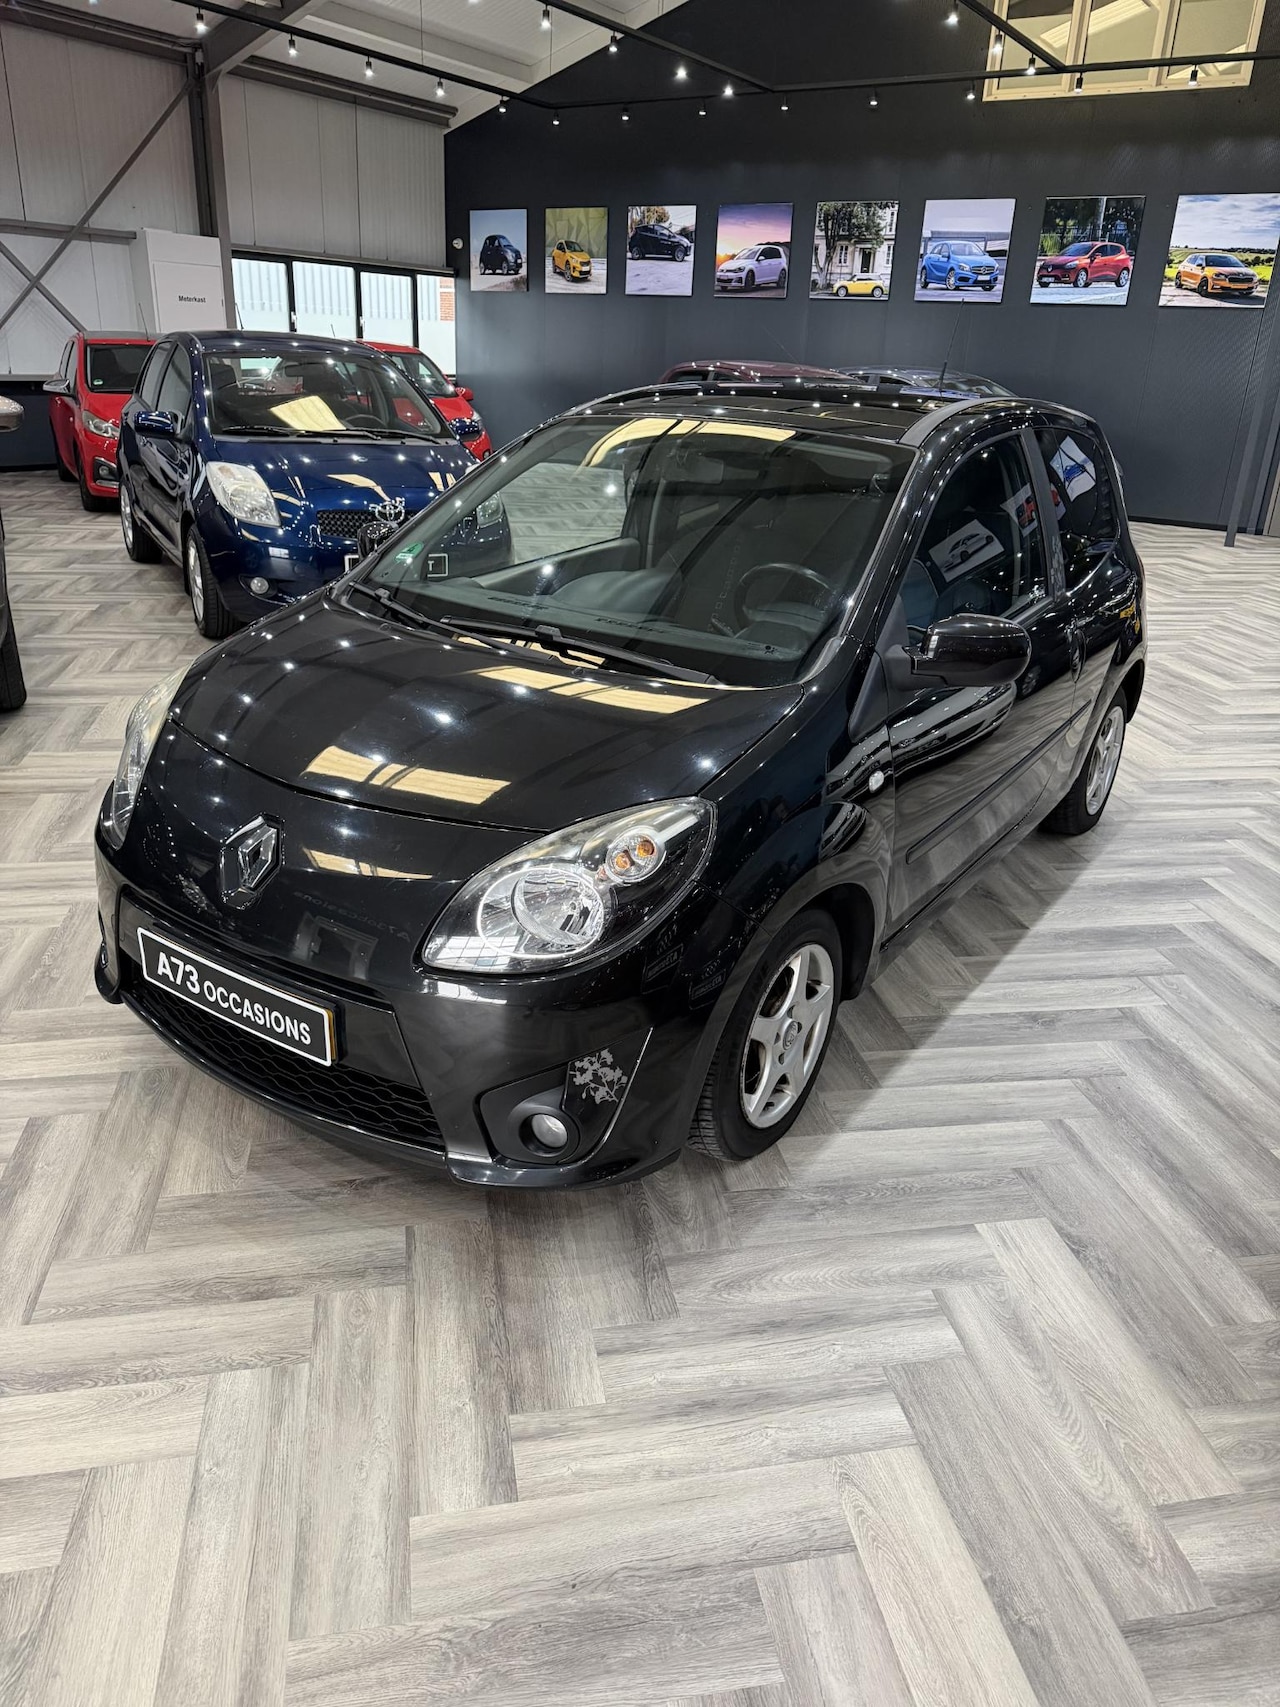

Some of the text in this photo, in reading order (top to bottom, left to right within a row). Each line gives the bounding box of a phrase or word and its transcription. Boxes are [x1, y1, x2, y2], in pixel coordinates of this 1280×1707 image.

[178, 295, 206, 303] Meterkast
[157, 951, 311, 1045] A73 OCCASIONS
